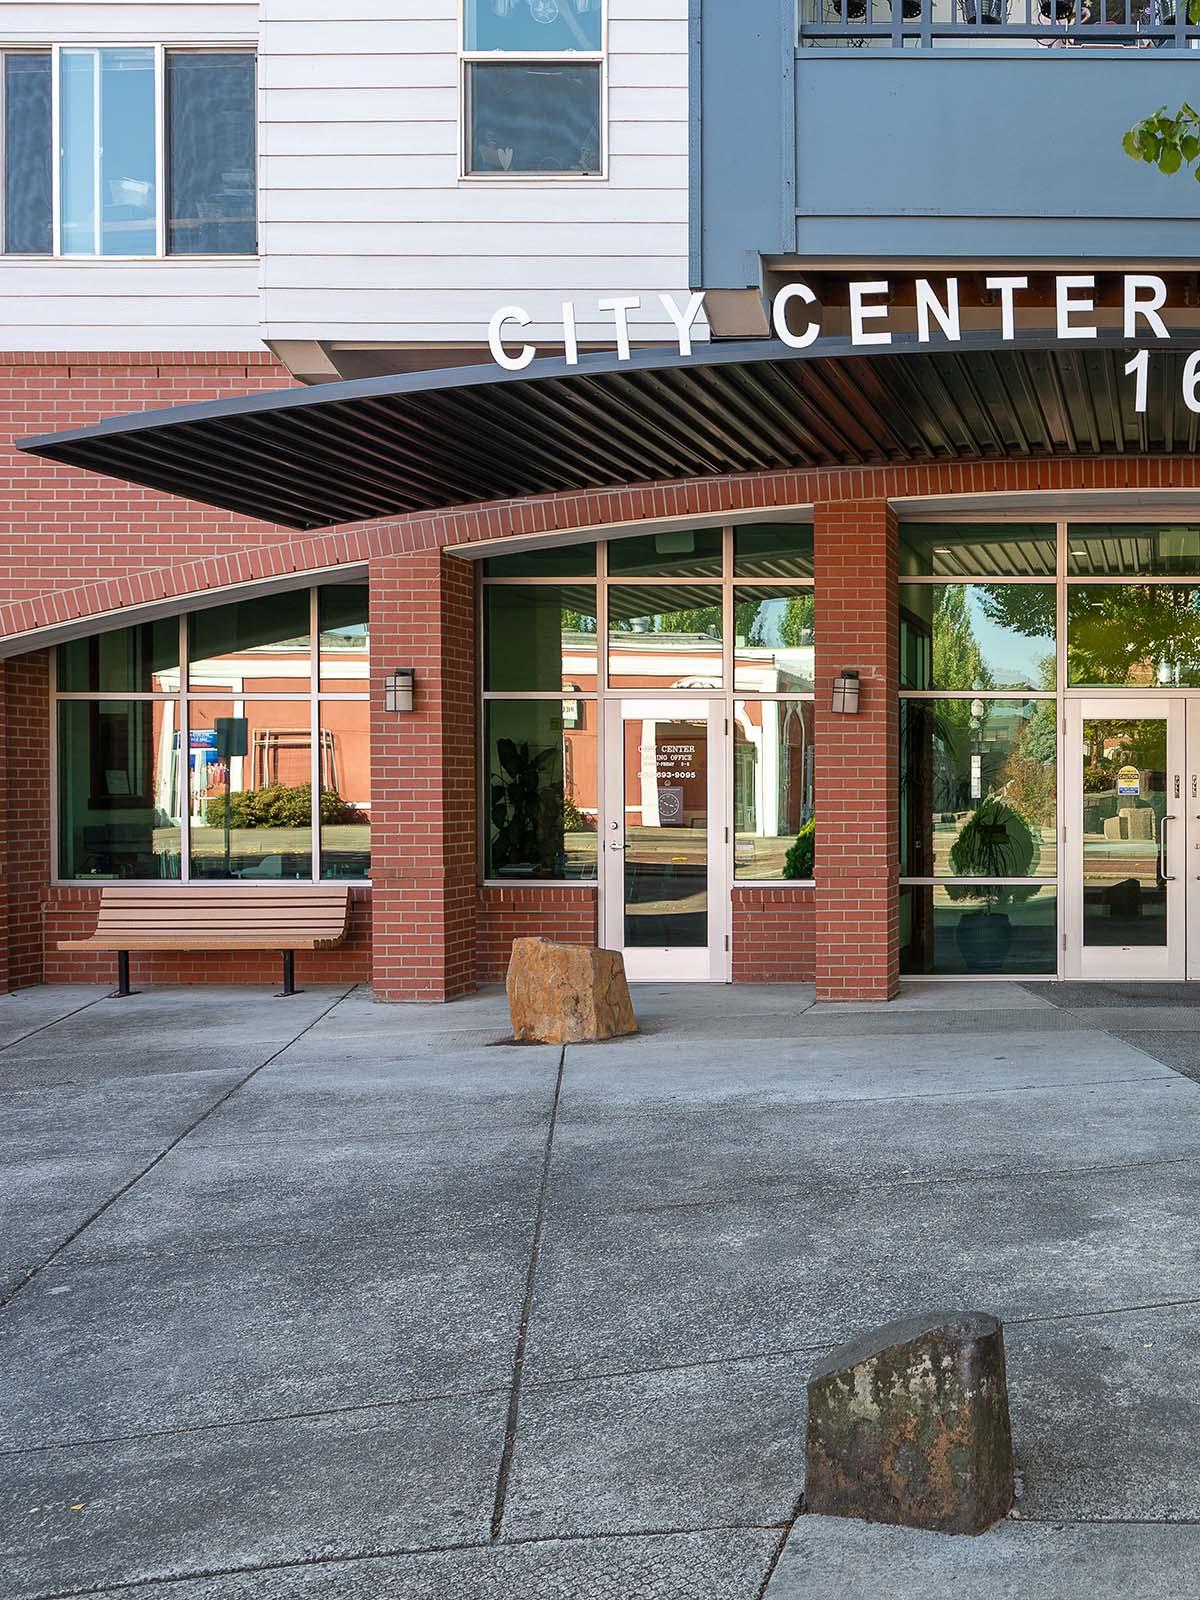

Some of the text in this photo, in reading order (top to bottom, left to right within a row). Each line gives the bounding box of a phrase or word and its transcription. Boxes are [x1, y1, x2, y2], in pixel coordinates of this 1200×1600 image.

[488, 291, 706, 371] CITY
[772, 275, 1170, 348] CENTER
[661, 745, 695, 753] CENTER
